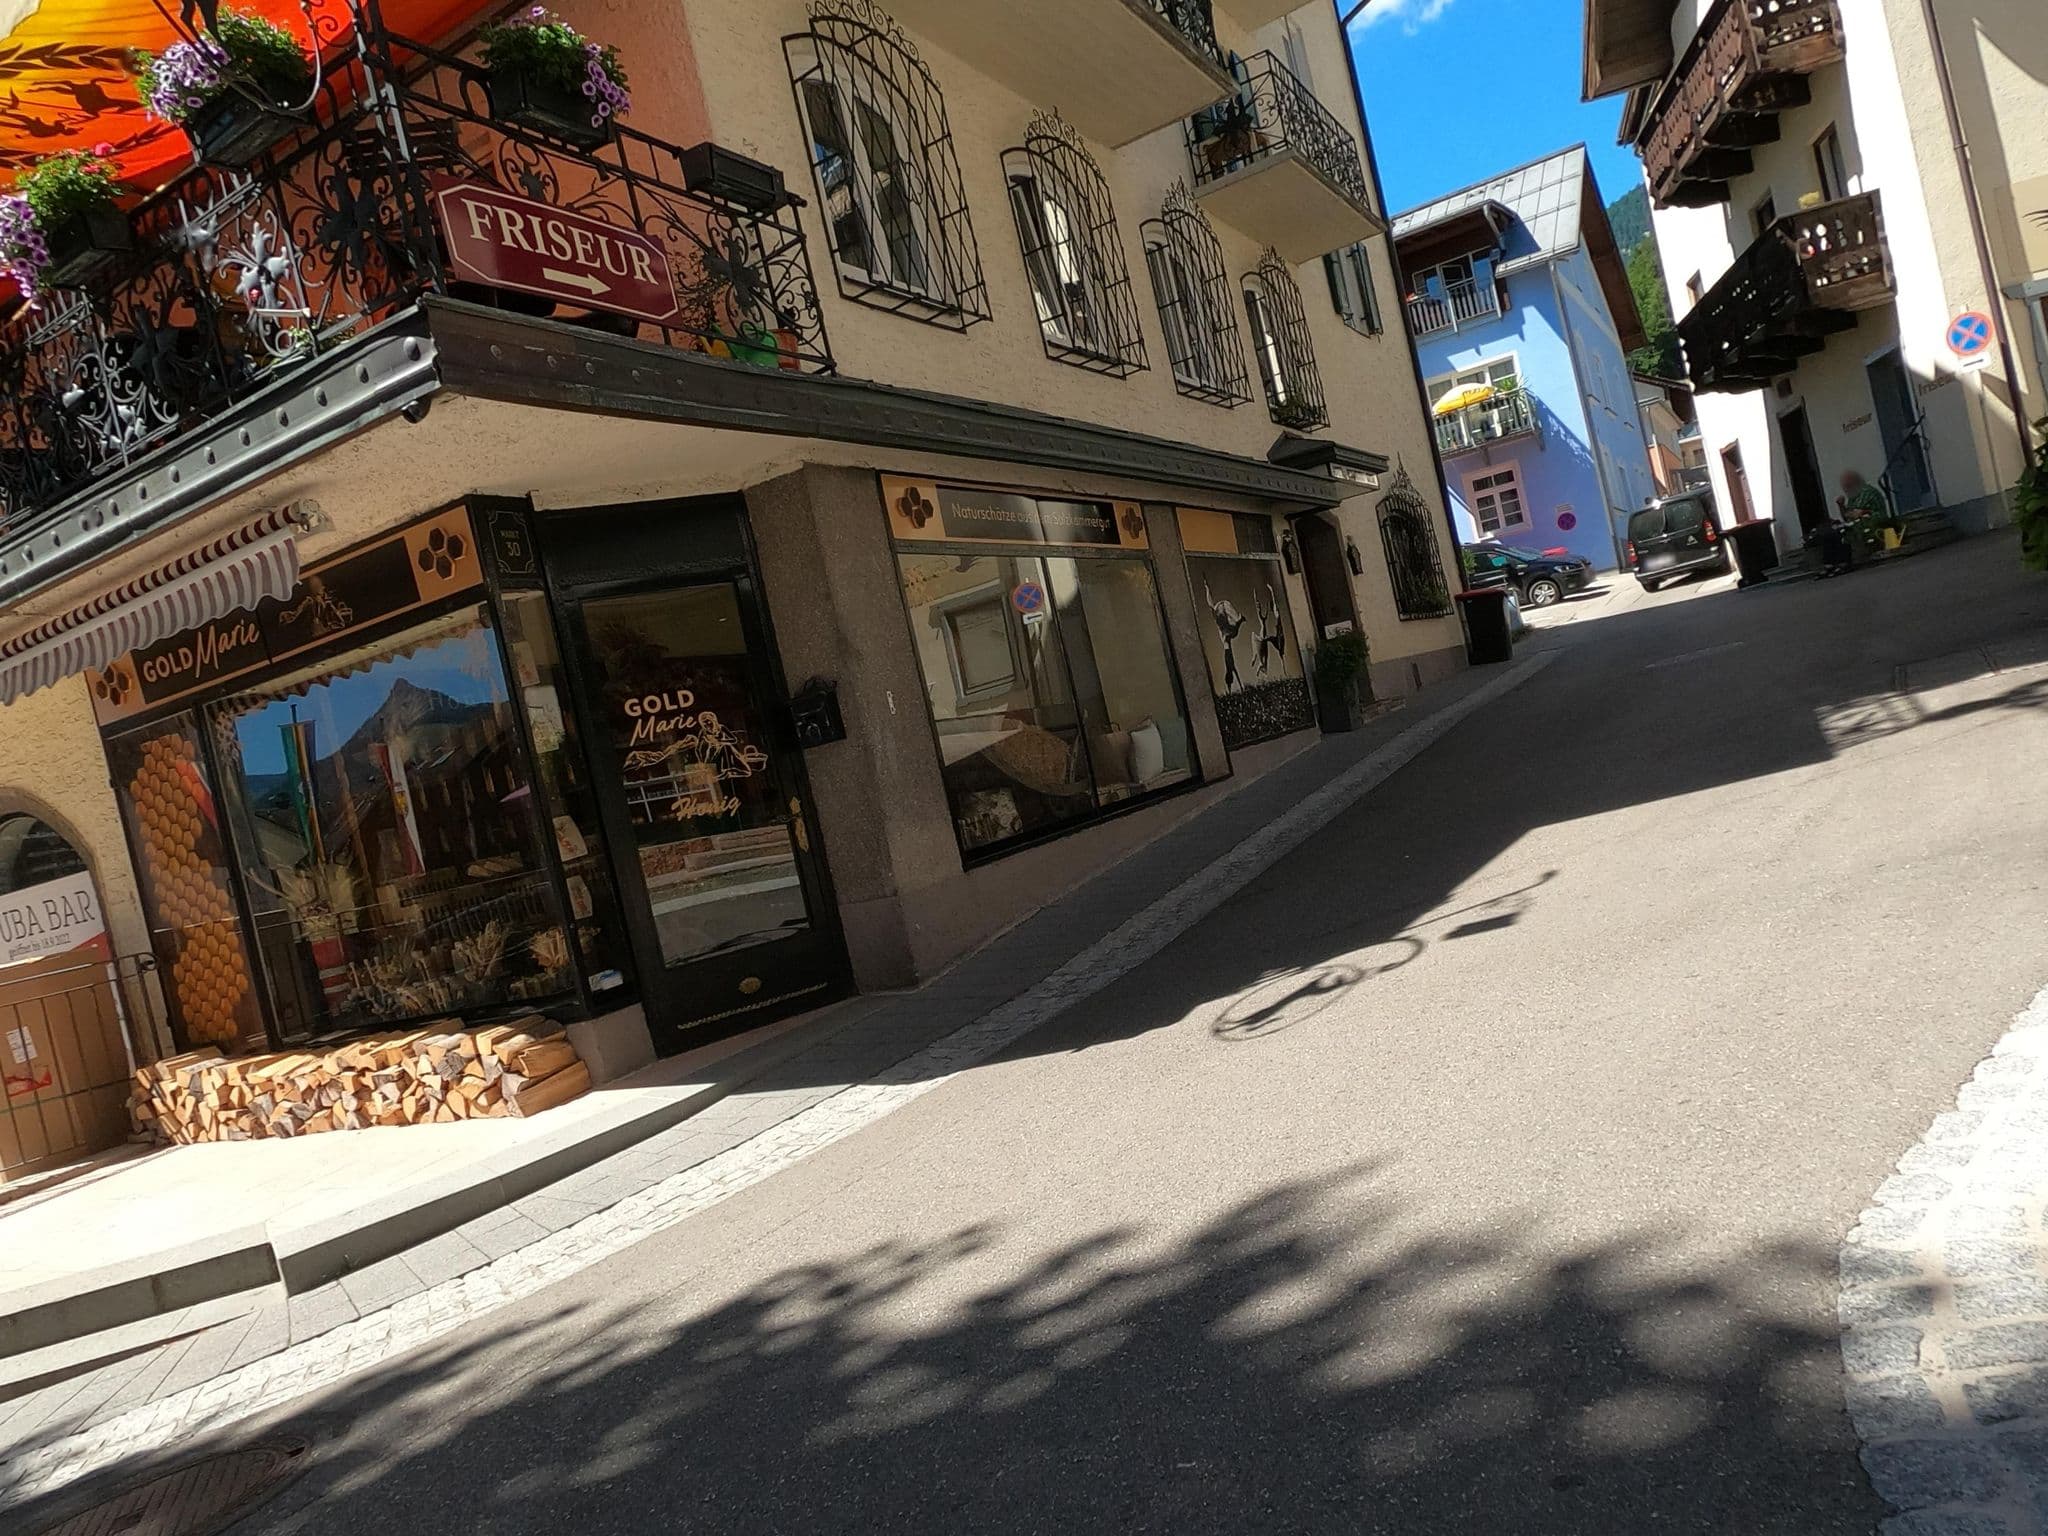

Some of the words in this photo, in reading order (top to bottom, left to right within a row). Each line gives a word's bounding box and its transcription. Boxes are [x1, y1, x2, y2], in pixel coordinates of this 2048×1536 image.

[460, 198, 659, 285] FRISEUR
[143, 647, 193, 683] GOLD
[195, 618, 260, 678] Marie
[624, 690, 695, 717] GOLD
[629, 713, 697, 747] Marie
[42, 890, 95, 931] BAR
